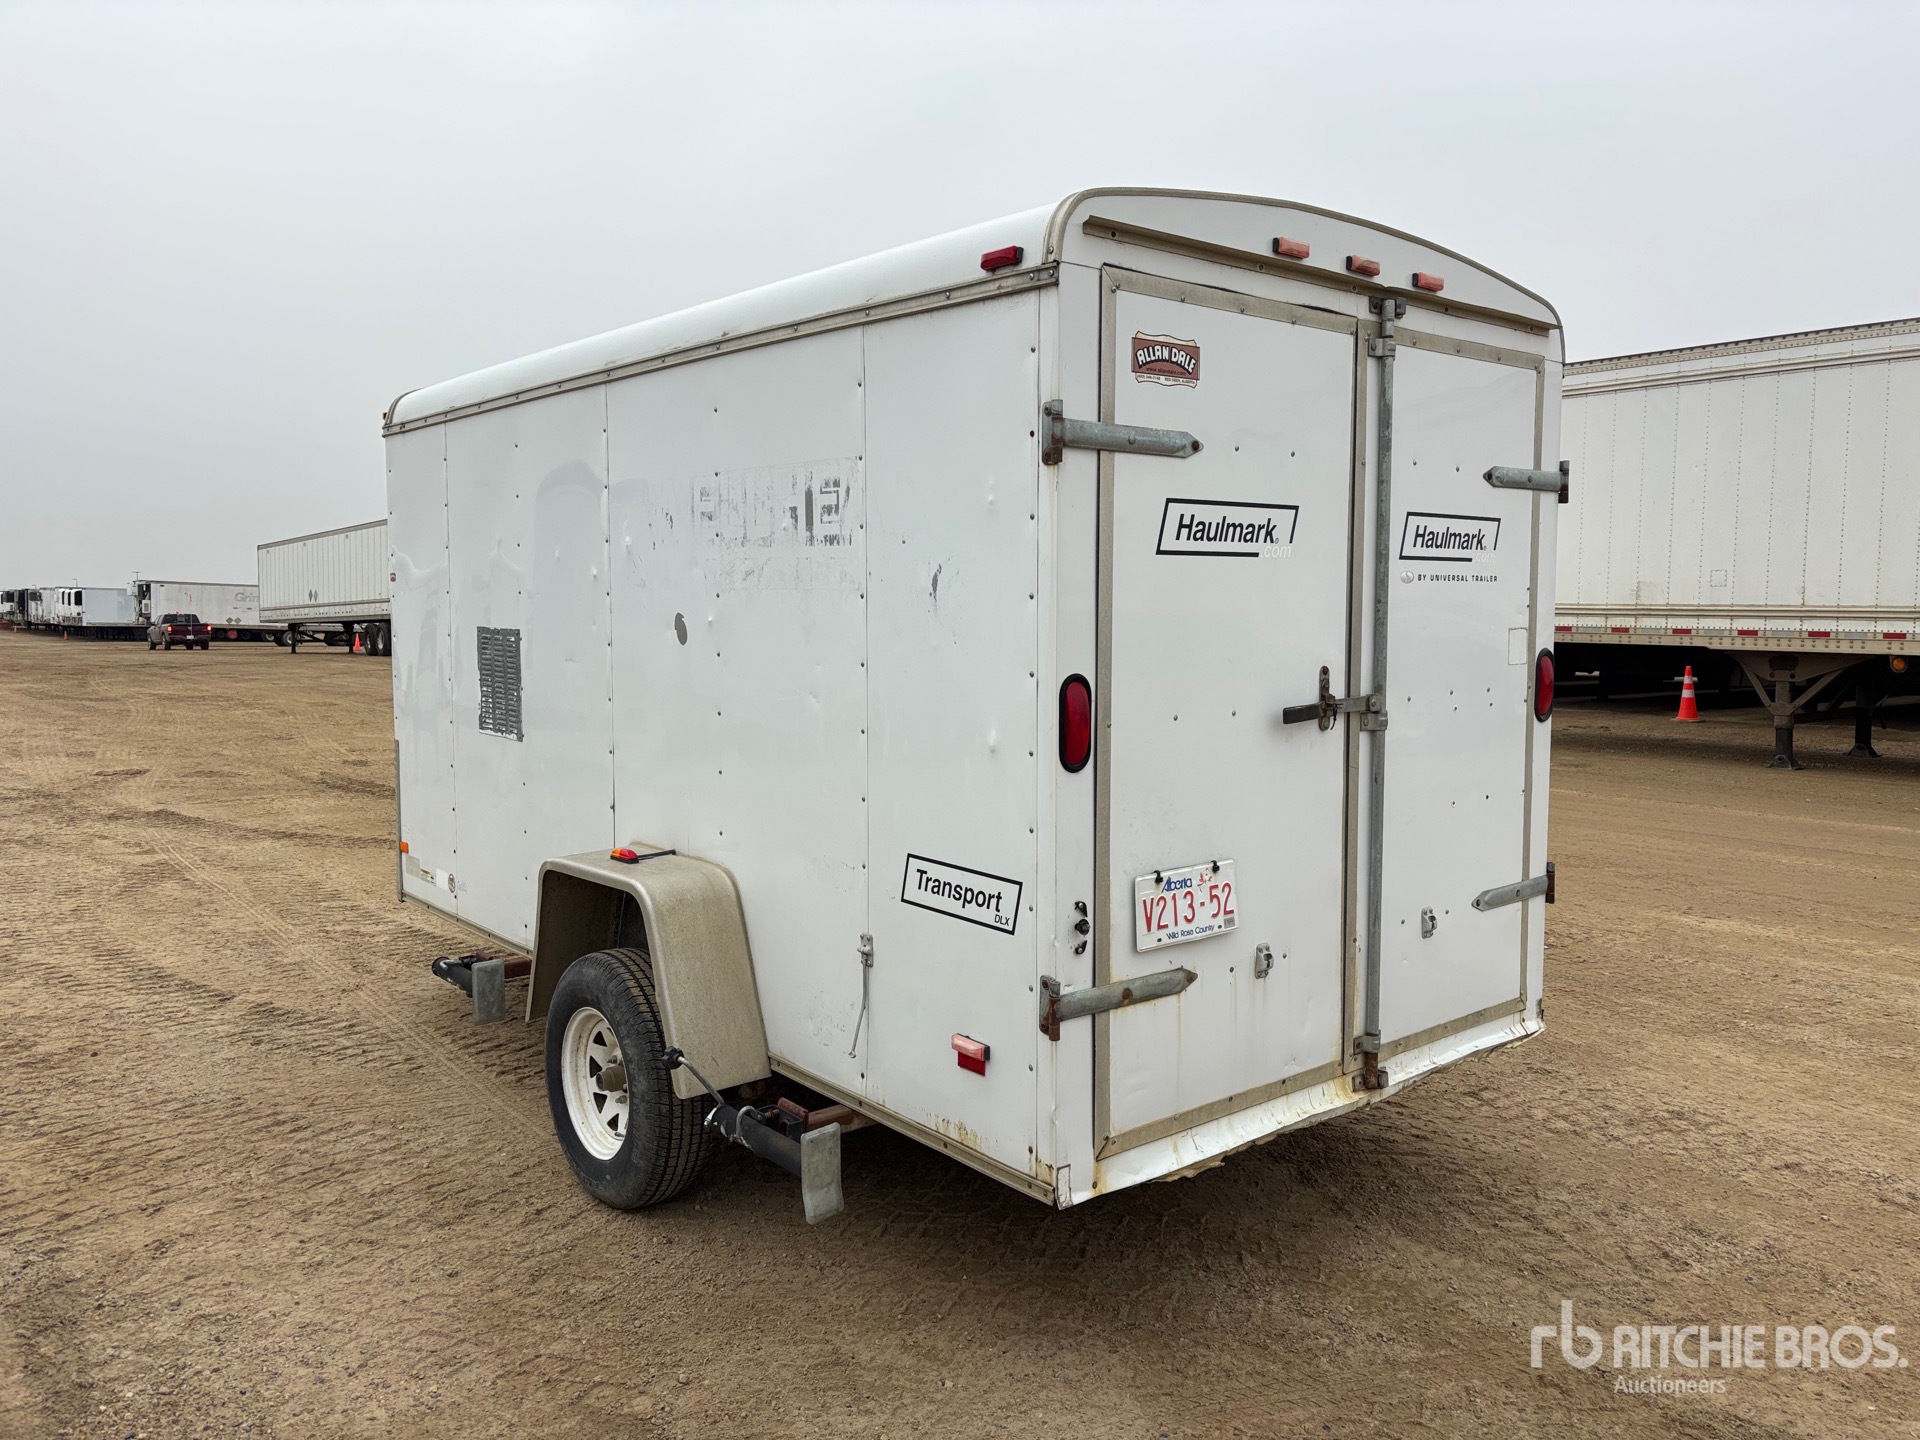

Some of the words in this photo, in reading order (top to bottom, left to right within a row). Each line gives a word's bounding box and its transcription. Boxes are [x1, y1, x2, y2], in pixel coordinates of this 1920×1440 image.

[1136, 345, 1169, 366] ALLAN
[1171, 347, 1196, 373] DALE
[1175, 513, 1277, 544] Haulmark
[1413, 524, 1485, 551] Haulmark
[1417, 573, 1427, 581] BY
[1430, 574, 1468, 582] UNIVERSAL
[916, 868, 1002, 913] Transport
[1161, 876, 1193, 893] Alberta
[994, 914, 1010, 927] DLX
[1142, 882, 1235, 933] V213-52
[1166, 931, 1180, 940] Wild
[1181, 928, 1194, 937] Rose
[1195, 924, 1215, 935] County
